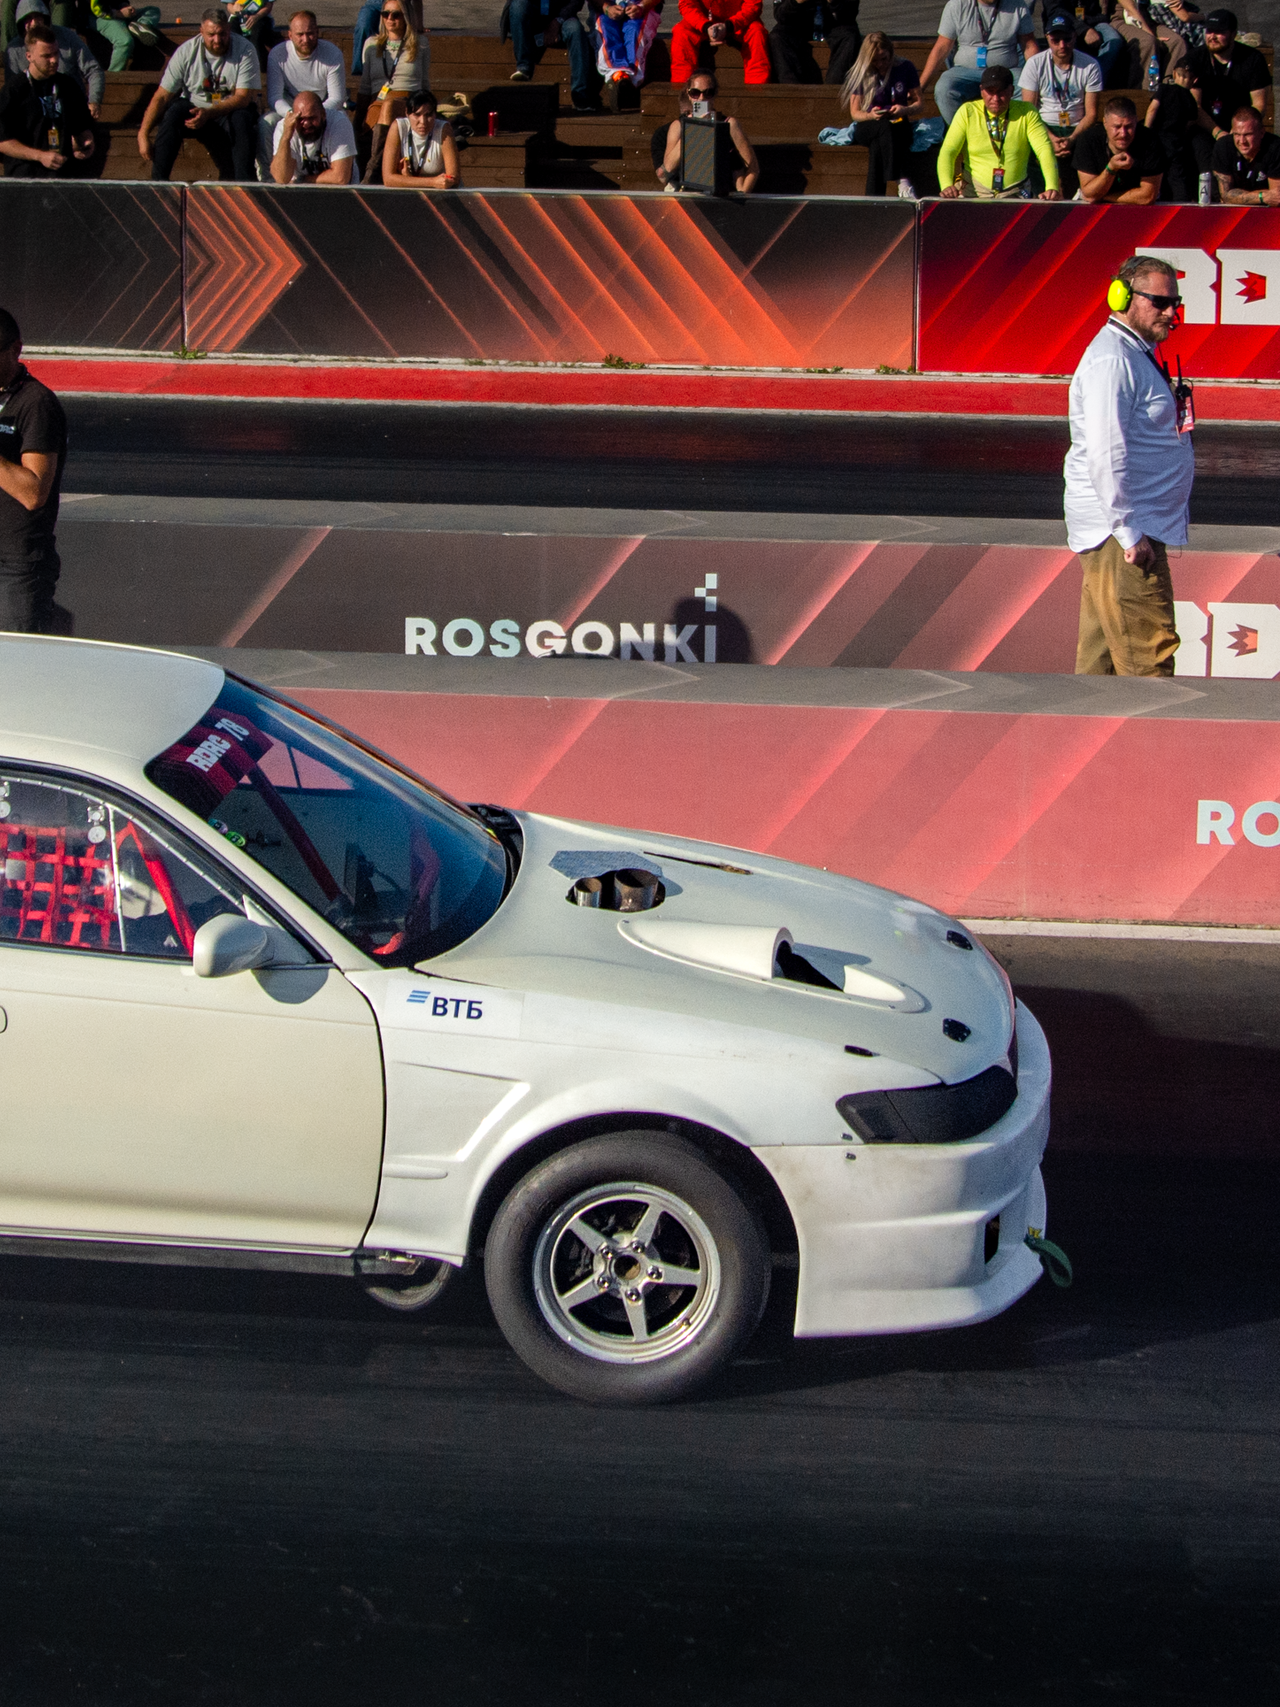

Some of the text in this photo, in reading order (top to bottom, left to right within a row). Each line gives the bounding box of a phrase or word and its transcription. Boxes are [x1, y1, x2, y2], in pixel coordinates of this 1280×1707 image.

[404, 617, 718, 664] ROSGONKI
[214, 717, 250, 742] 78
[431, 996, 483, 1020] ВТБ
